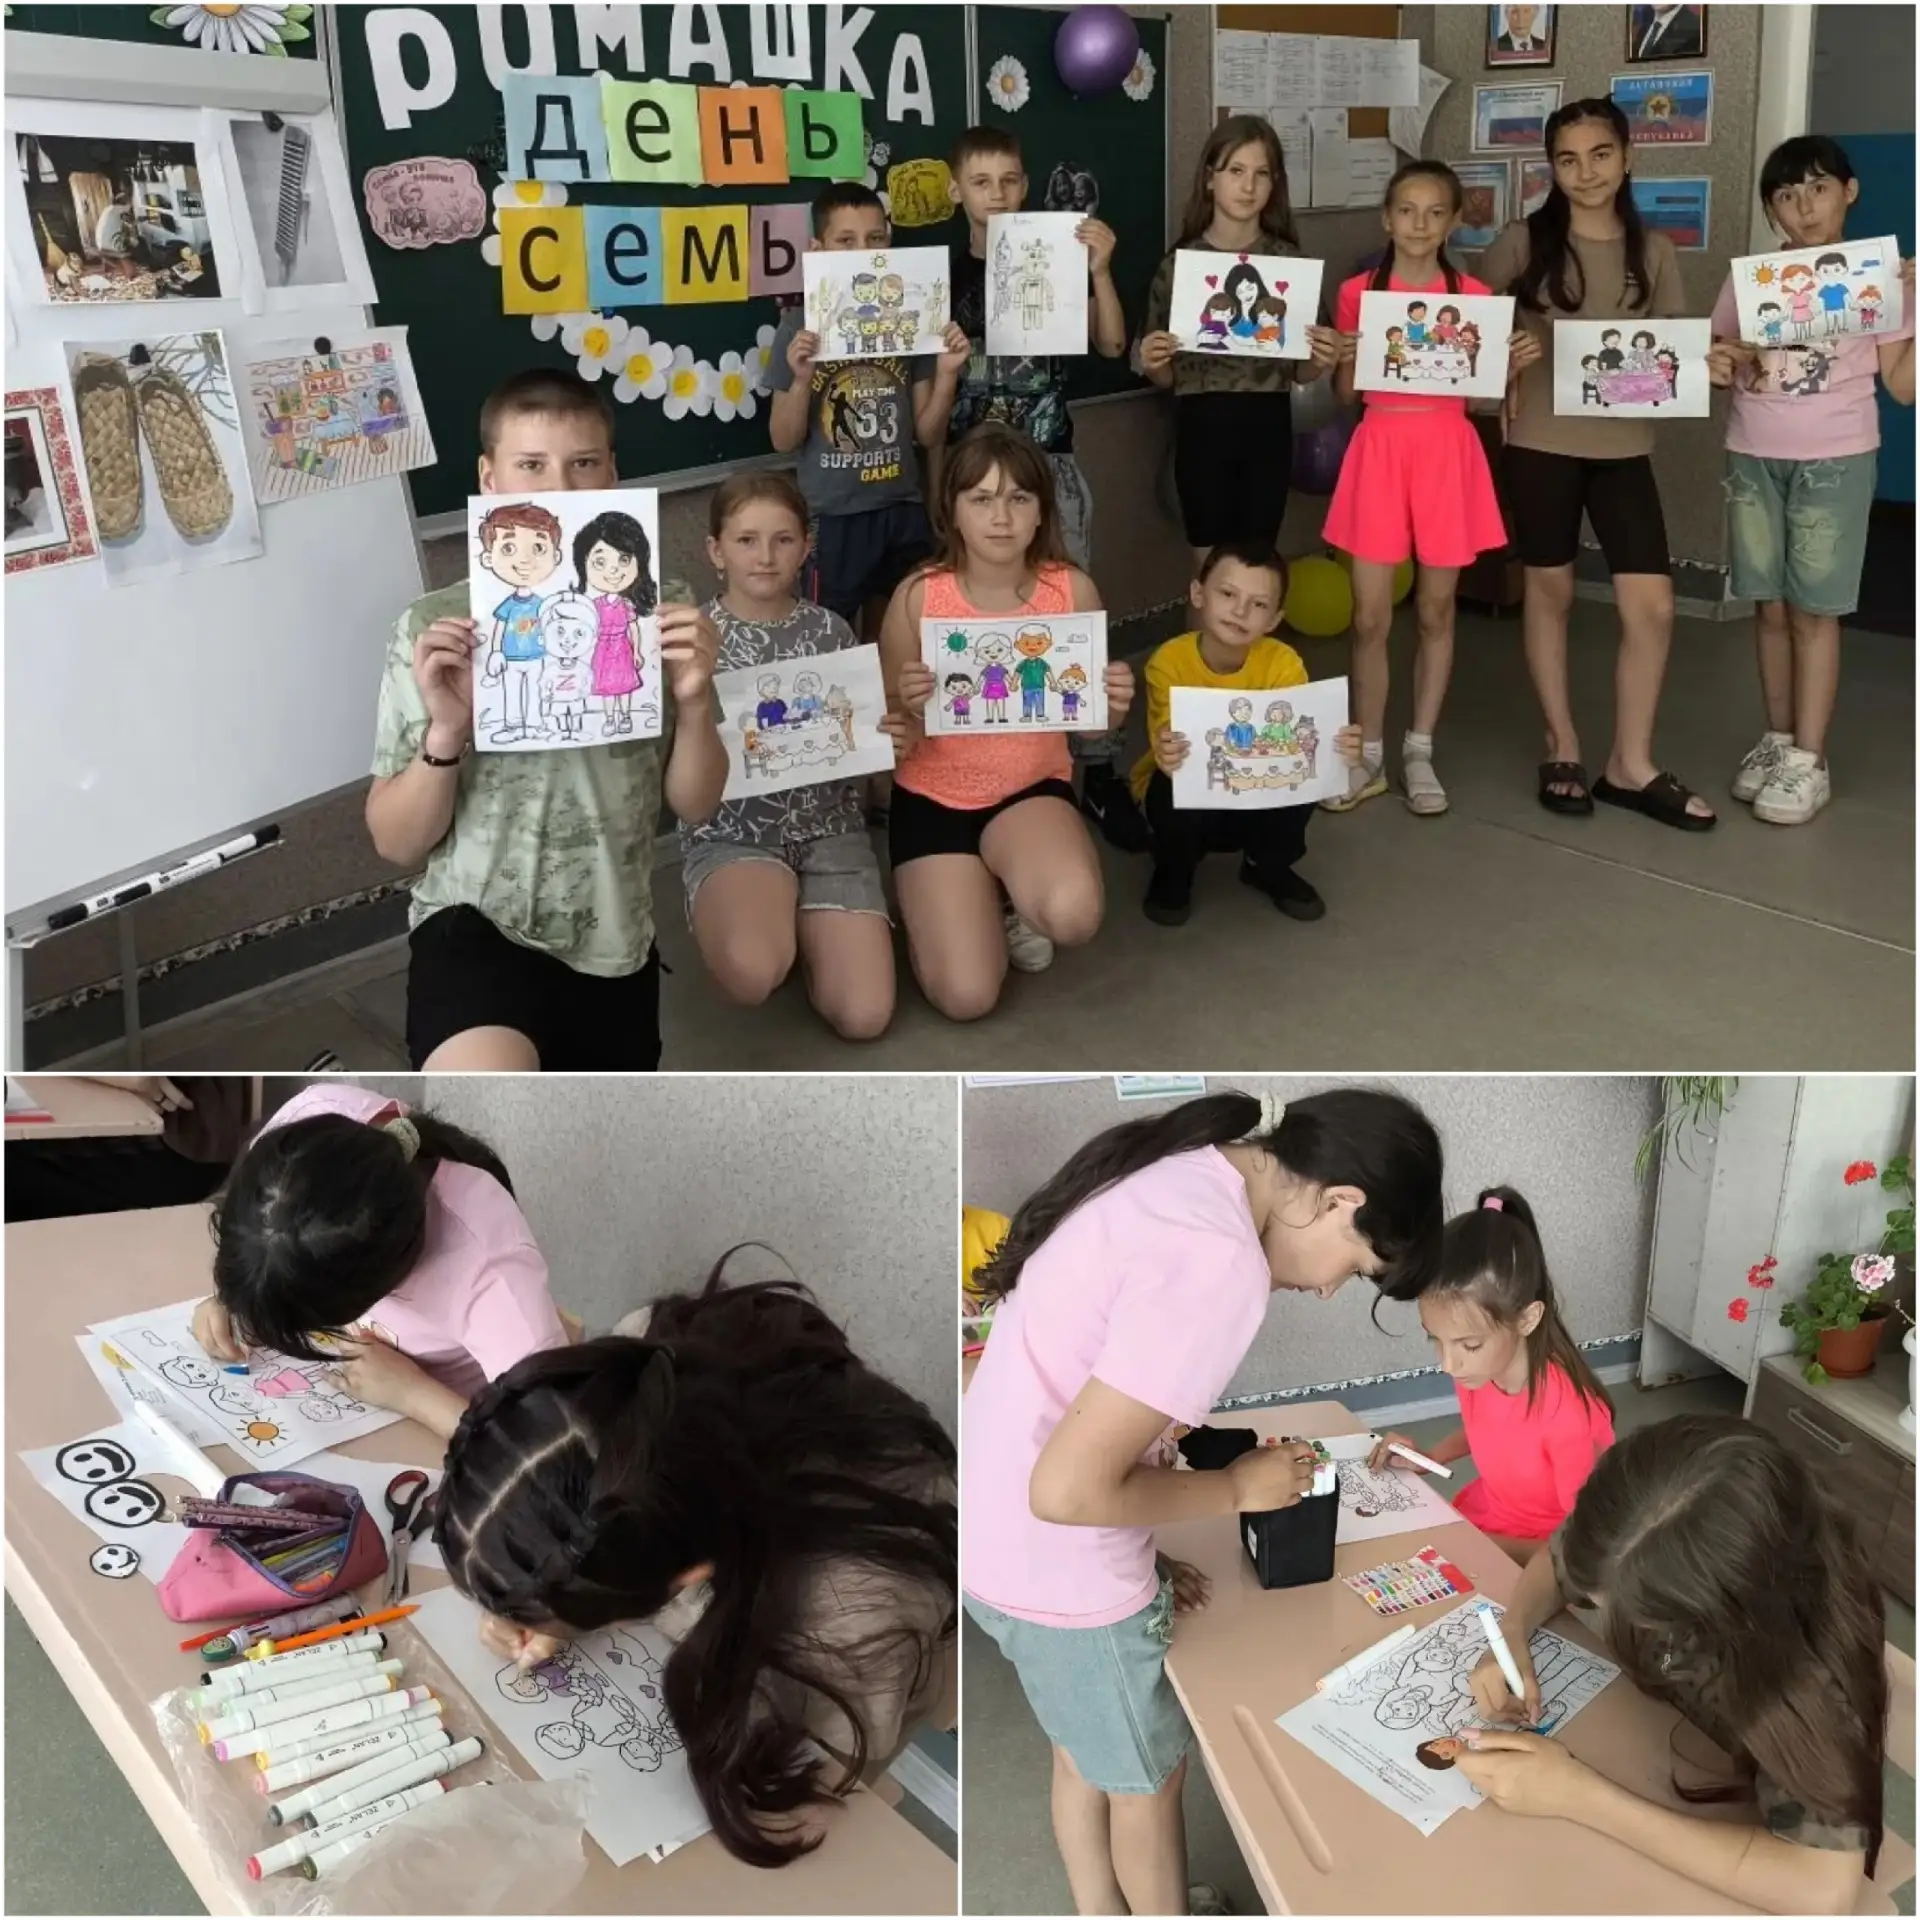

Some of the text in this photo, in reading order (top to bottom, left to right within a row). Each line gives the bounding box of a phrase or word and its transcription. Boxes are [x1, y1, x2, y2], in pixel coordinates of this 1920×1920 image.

[856, 398, 898, 443] 63
[820, 448, 901, 468] SUPPORTS
[861, 465, 900, 481] GAME
